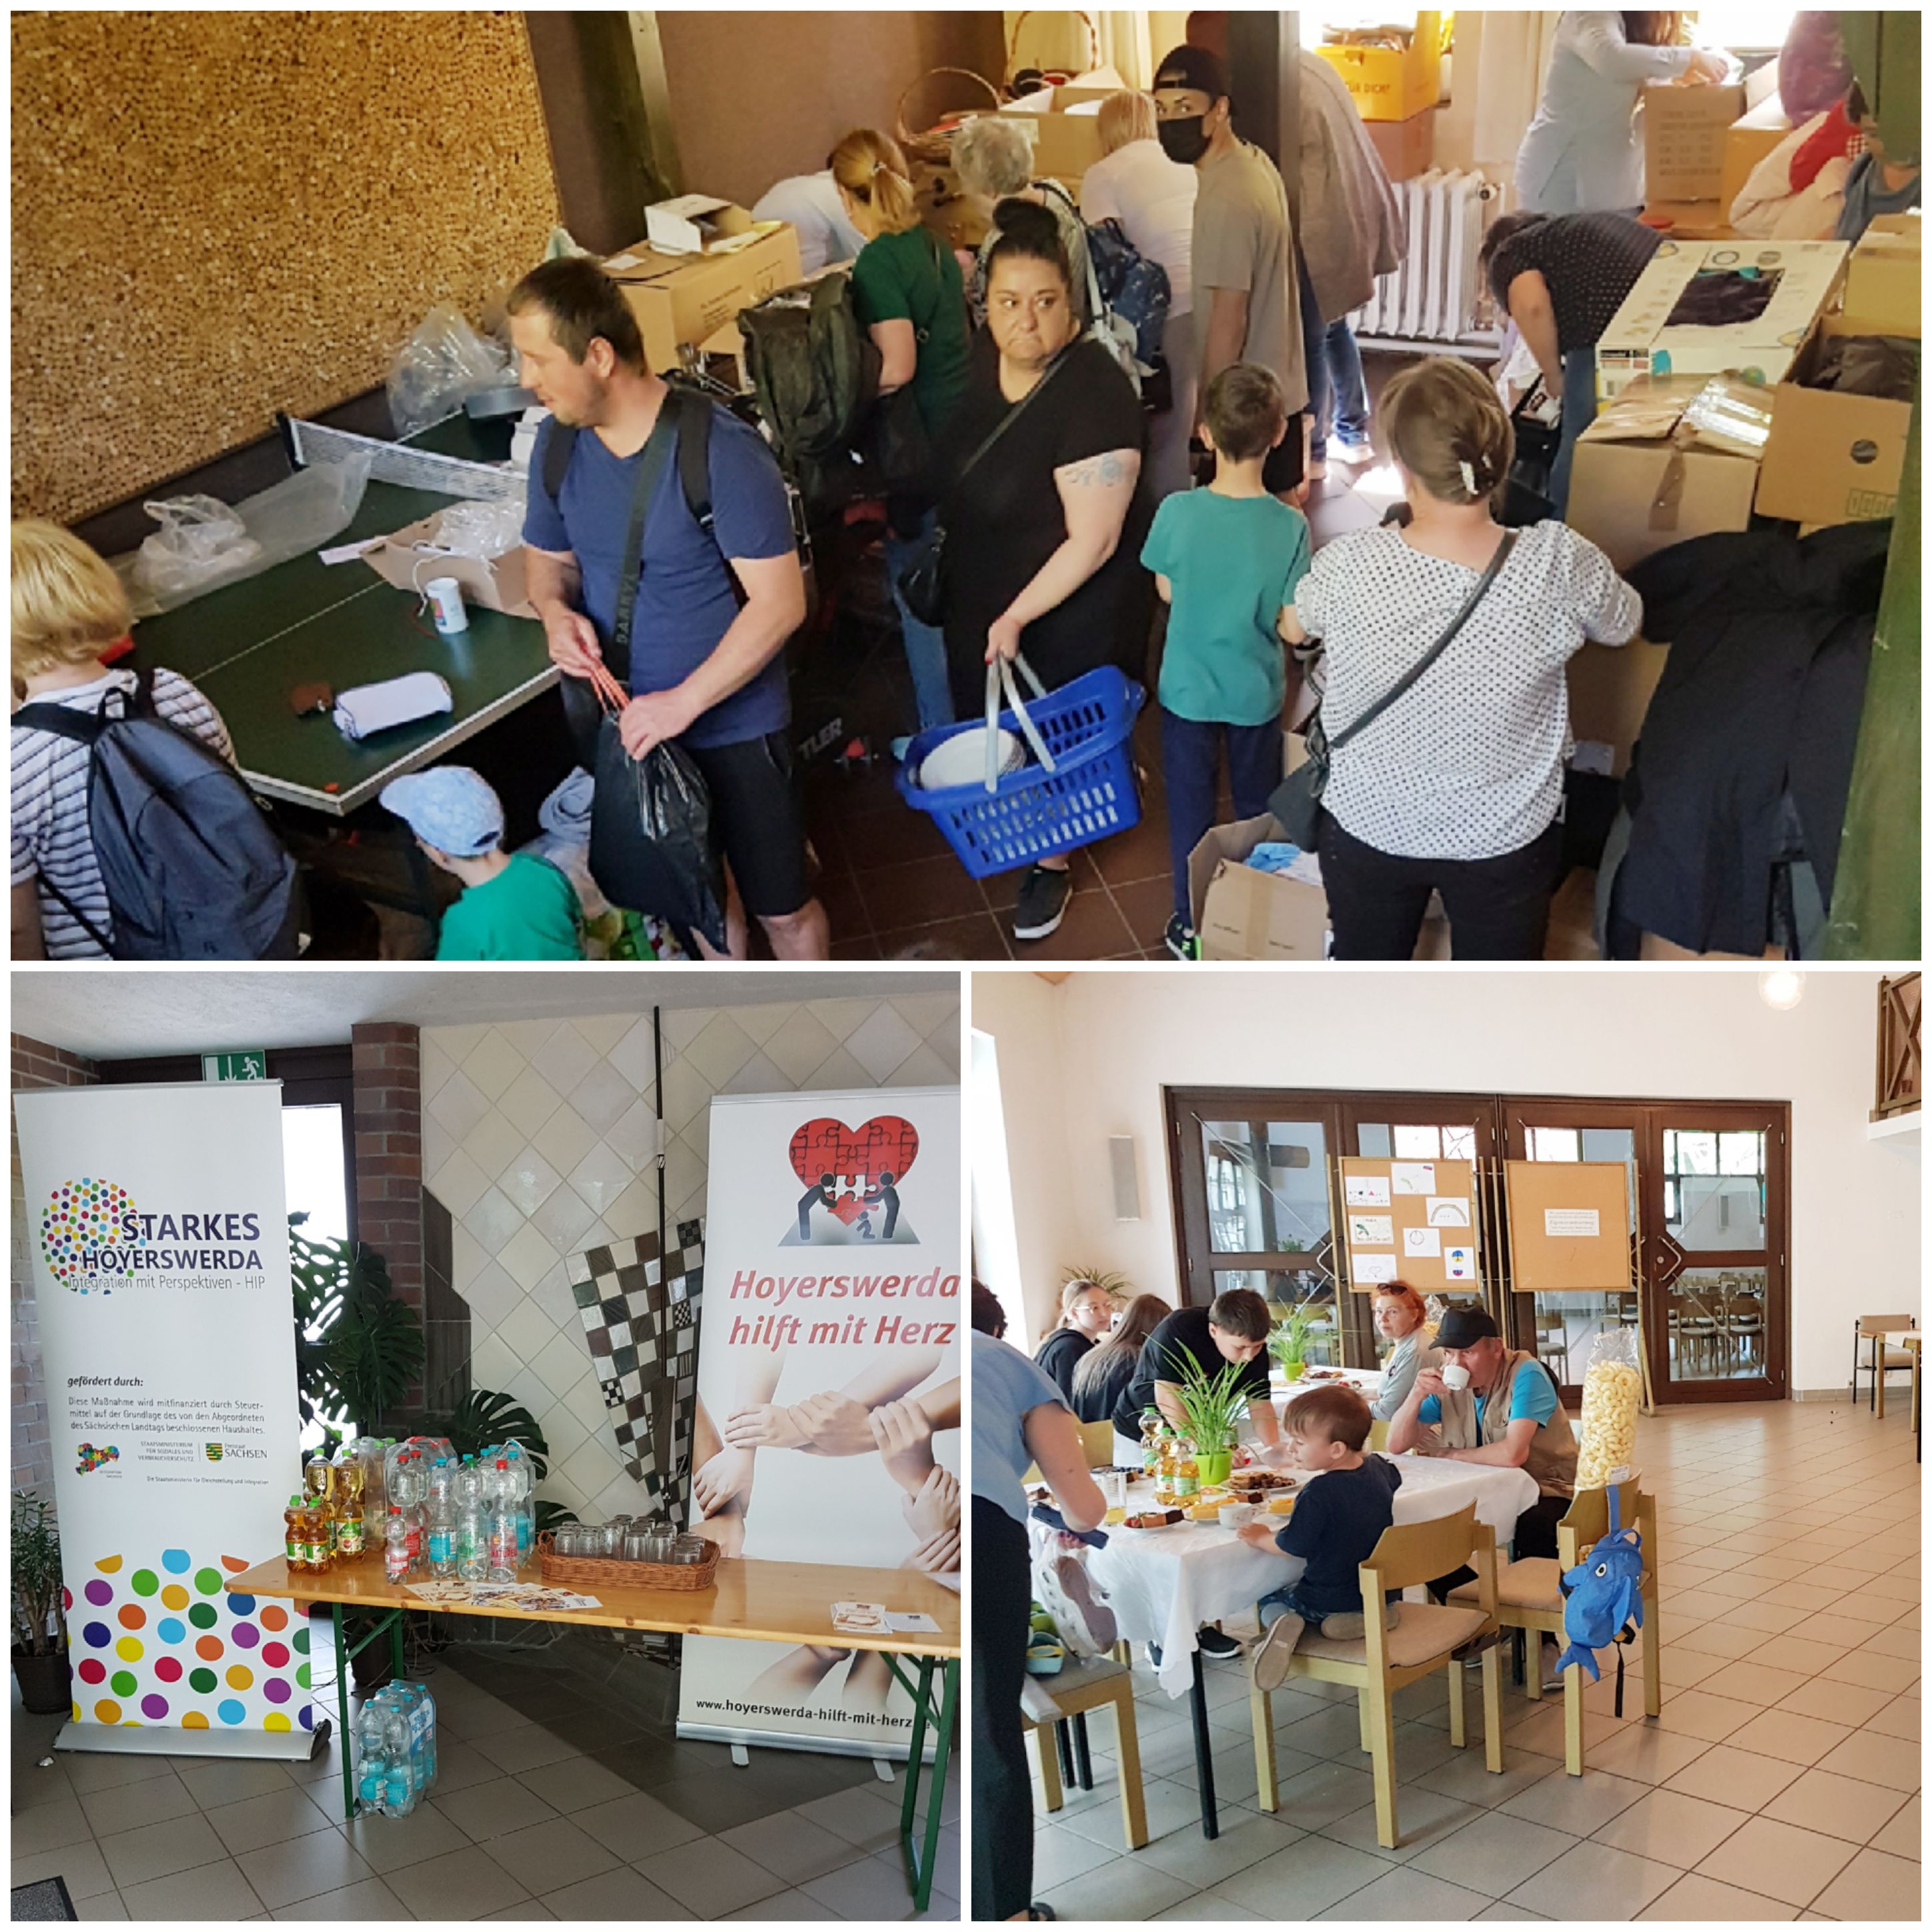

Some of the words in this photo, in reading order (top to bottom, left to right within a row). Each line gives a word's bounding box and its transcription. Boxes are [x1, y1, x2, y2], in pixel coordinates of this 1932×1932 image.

[122, 1213, 261, 1242] STARKES
[82, 1249, 263, 1270] HOYERSWERDA
[68, 1274, 132, 1290] Integration
[136, 1274, 155, 1289] mit
[159, 1275, 232, 1292] Perspektiven
[245, 1276, 266, 1290] HIP
[729, 1266, 961, 1307] Hoyerswerda
[729, 1315, 801, 1353] hilft
[808, 1314, 867, 1344] mit
[874, 1316, 956, 1345] Herz
[67, 1376, 112, 1388] gefördert
[113, 1376, 143, 1386] durch:
[69, 1397, 88, 1406] Diese
[91, 1398, 134, 1406] Maßnahme
[137, 1398, 153, 1406] wird
[157, 1398, 207, 1408] mitfinanziert
[210, 1400, 232, 1408] durch
[235, 1400, 264, 1409] Steuer-
[70, 1410, 91, 1418] mittel
[94, 1410, 107, 1418] auf
[109, 1410, 121, 1418] der
[123, 1410, 161, 1421] Grundlage
[163, 1411, 177, 1420] des
[195, 1412, 209, 1420] den
[212, 1412, 265, 1423] Abgeordneten
[84, 1421, 130, 1430] Sächsischen
[131, 1422, 165, 1433] Landtags
[166, 1424, 220, 1433] beschlossenen
[222, 1425, 266, 1434] Haushaltes.
[224, 1449, 268, 1458] SACHSEN
